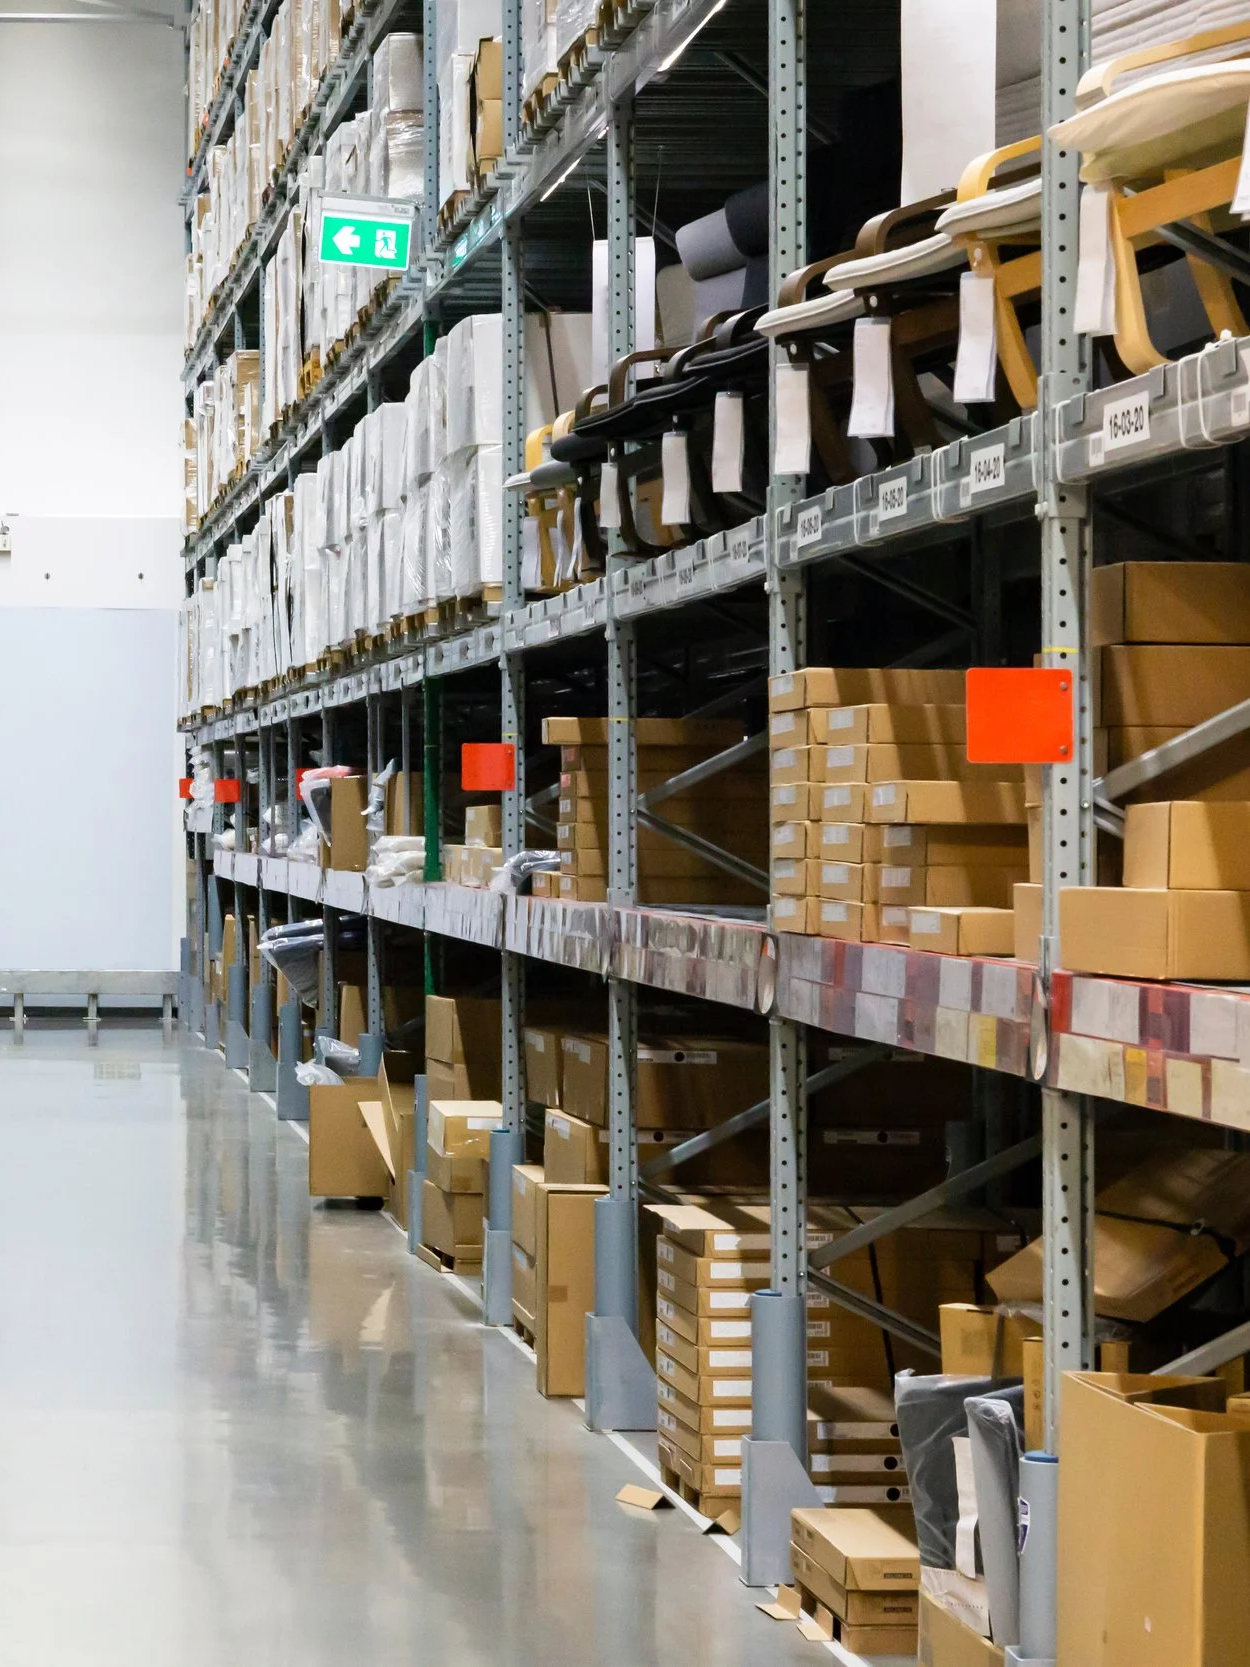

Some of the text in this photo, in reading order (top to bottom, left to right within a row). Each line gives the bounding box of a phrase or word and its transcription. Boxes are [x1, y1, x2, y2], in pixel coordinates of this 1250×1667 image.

[1109, 405, 1144, 440] 16-03-20
[975, 456, 1001, 484] 16-04-20
[882, 486, 904, 512] 16-05-20
